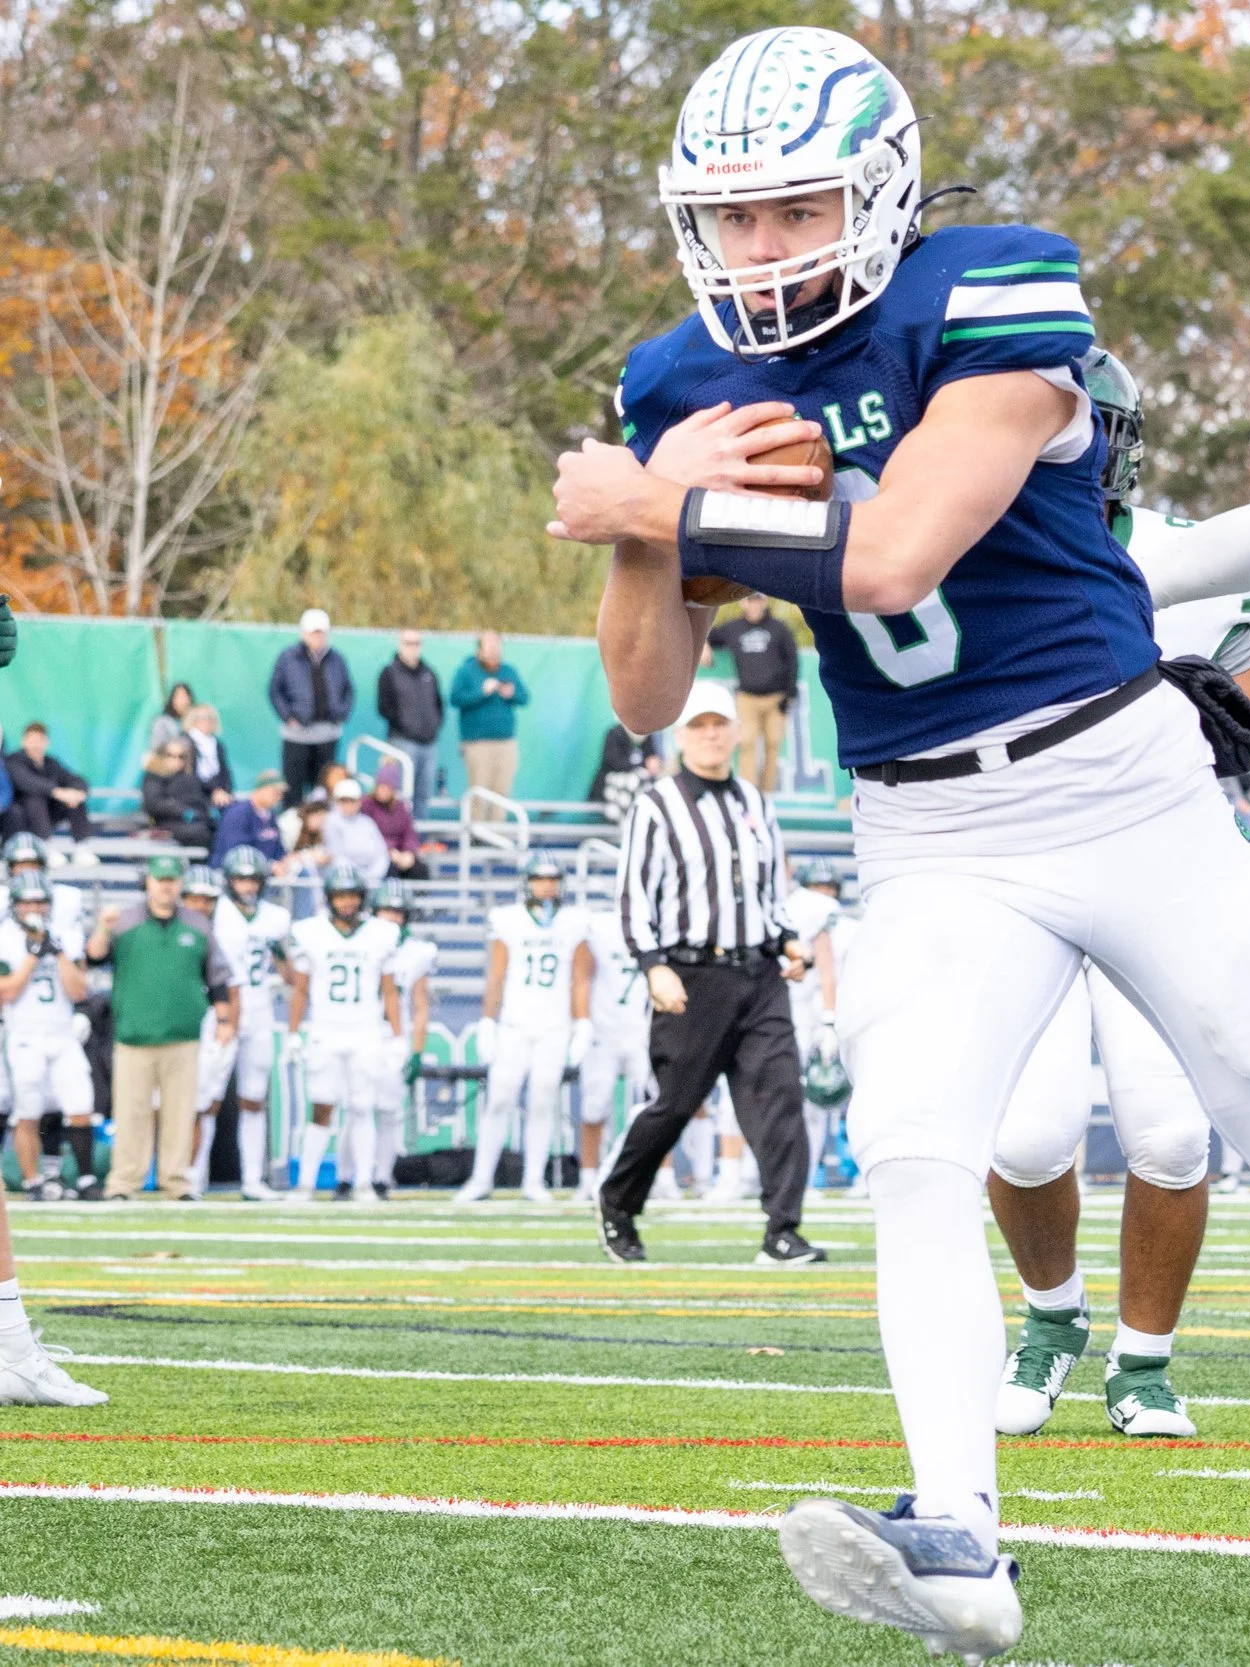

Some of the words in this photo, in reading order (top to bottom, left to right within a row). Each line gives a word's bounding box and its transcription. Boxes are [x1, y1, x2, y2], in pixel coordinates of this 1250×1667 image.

[705, 160, 763, 175] Riddell
[822, 390, 893, 454] LS
[329, 965, 361, 1003] 21
[524, 954, 559, 987] 19
